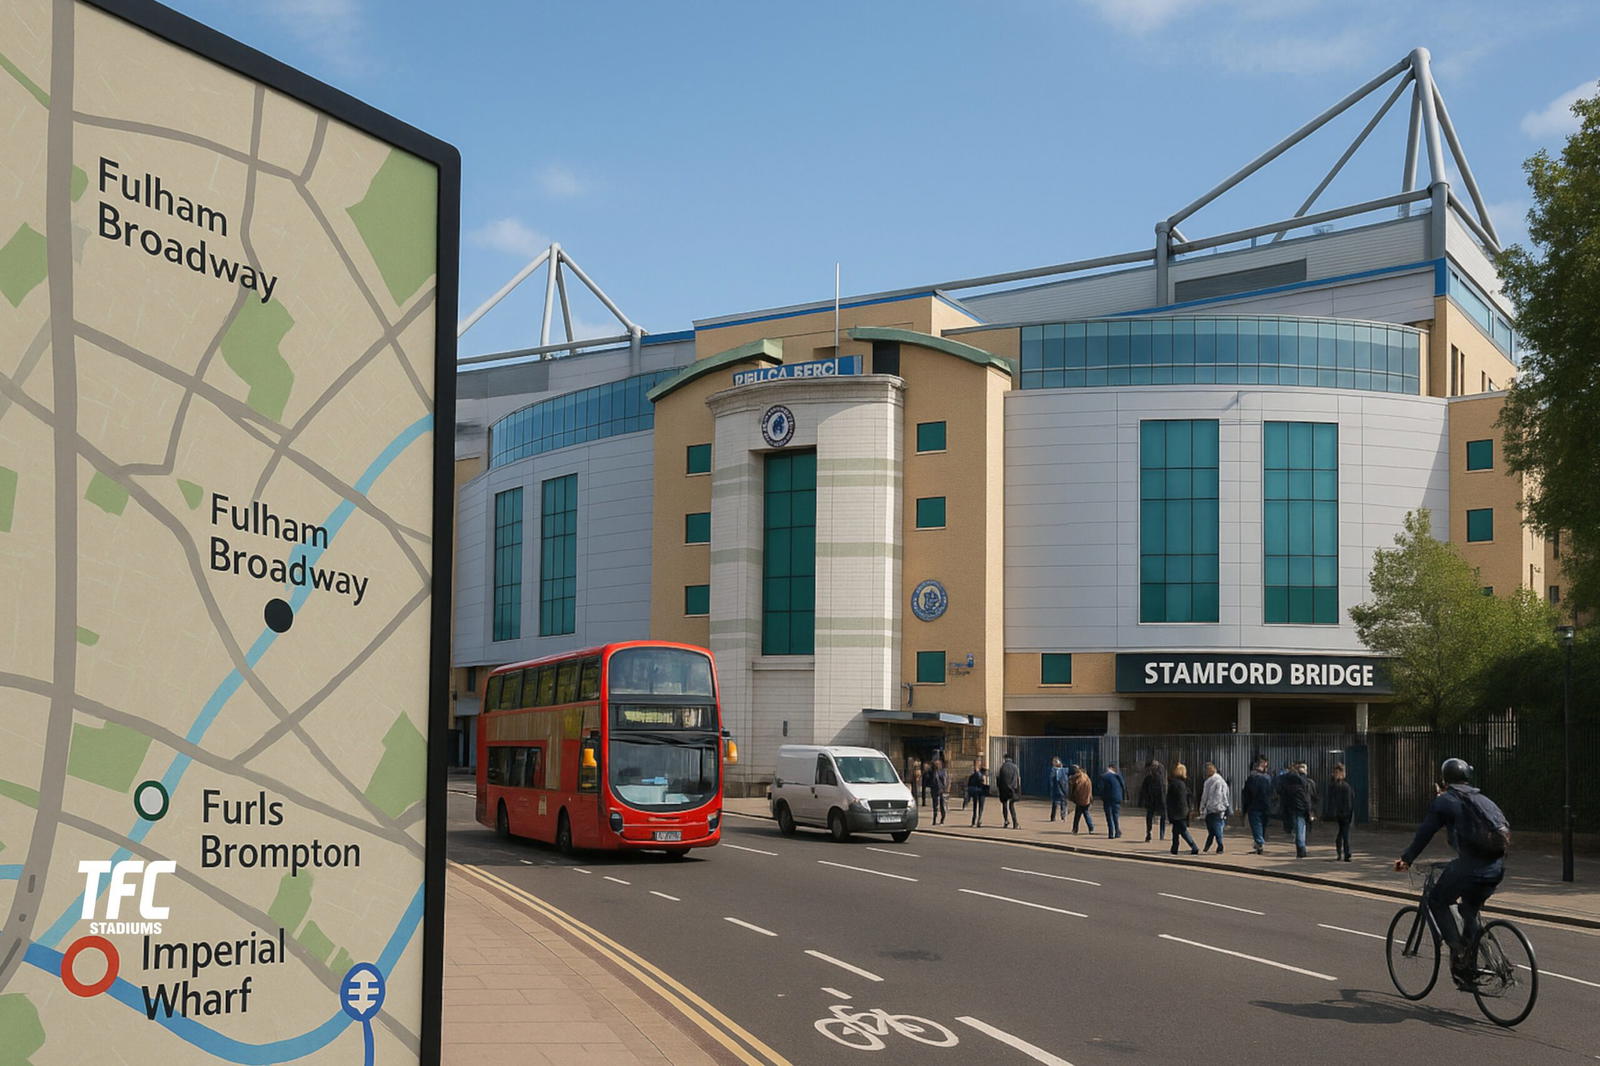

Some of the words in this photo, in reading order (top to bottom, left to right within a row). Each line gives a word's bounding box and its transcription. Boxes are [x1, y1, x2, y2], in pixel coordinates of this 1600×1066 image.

[100, 156, 227, 235] Fulham
[99, 202, 277, 303] Broadway
[211, 493, 328, 549] Fulham
[210, 537, 368, 605] Broadway
[1145, 662, 1283, 685] STAMFORD
[1290, 664, 1374, 686] BRIDGE
[203, 789, 284, 826] Furls
[202, 835, 360, 877] Brompton
[143, 928, 285, 977] Imperial
[142, 977, 251, 1020] Wharf
